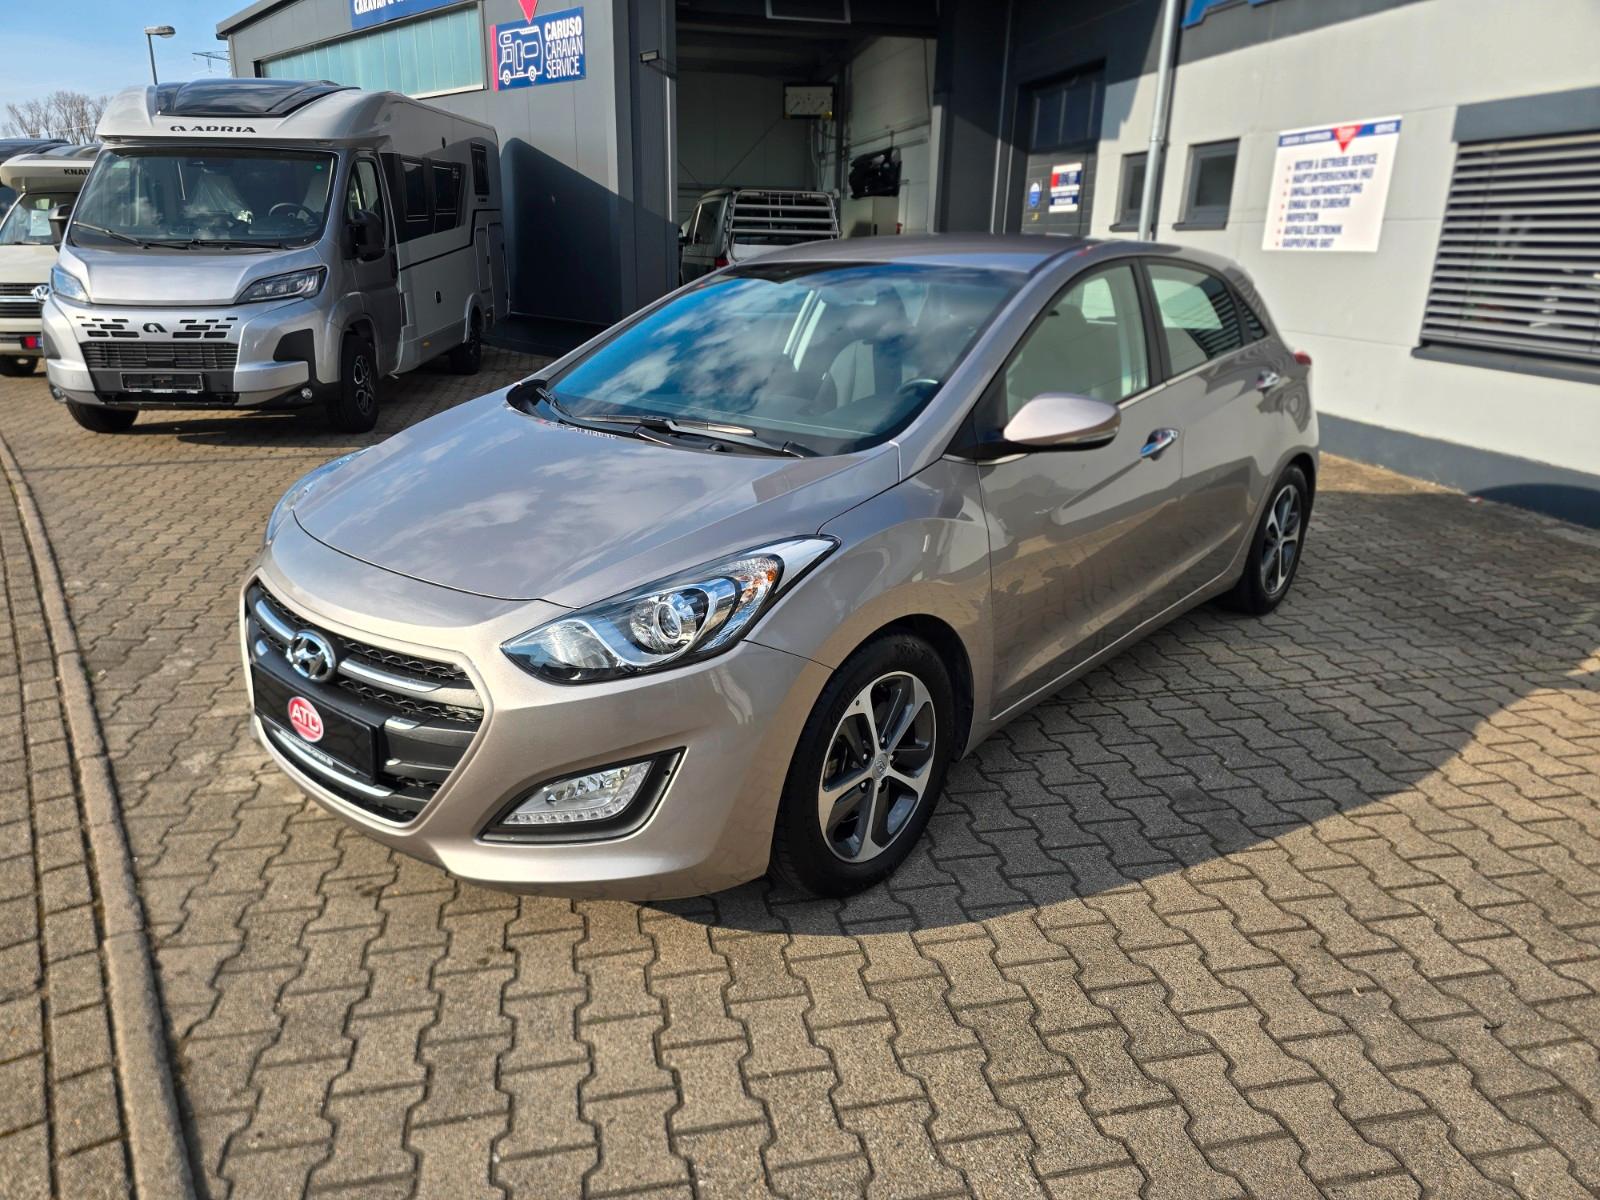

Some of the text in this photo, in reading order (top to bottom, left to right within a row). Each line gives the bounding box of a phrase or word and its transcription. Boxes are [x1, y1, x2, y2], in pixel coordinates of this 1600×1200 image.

[544, 16, 582, 42] CARUSO
[545, 36, 583, 60] CARAVAN
[546, 56, 581, 79] SERVICE
[191, 126, 257, 134] ADRIA
[1351, 153, 1378, 165] SERVICE
